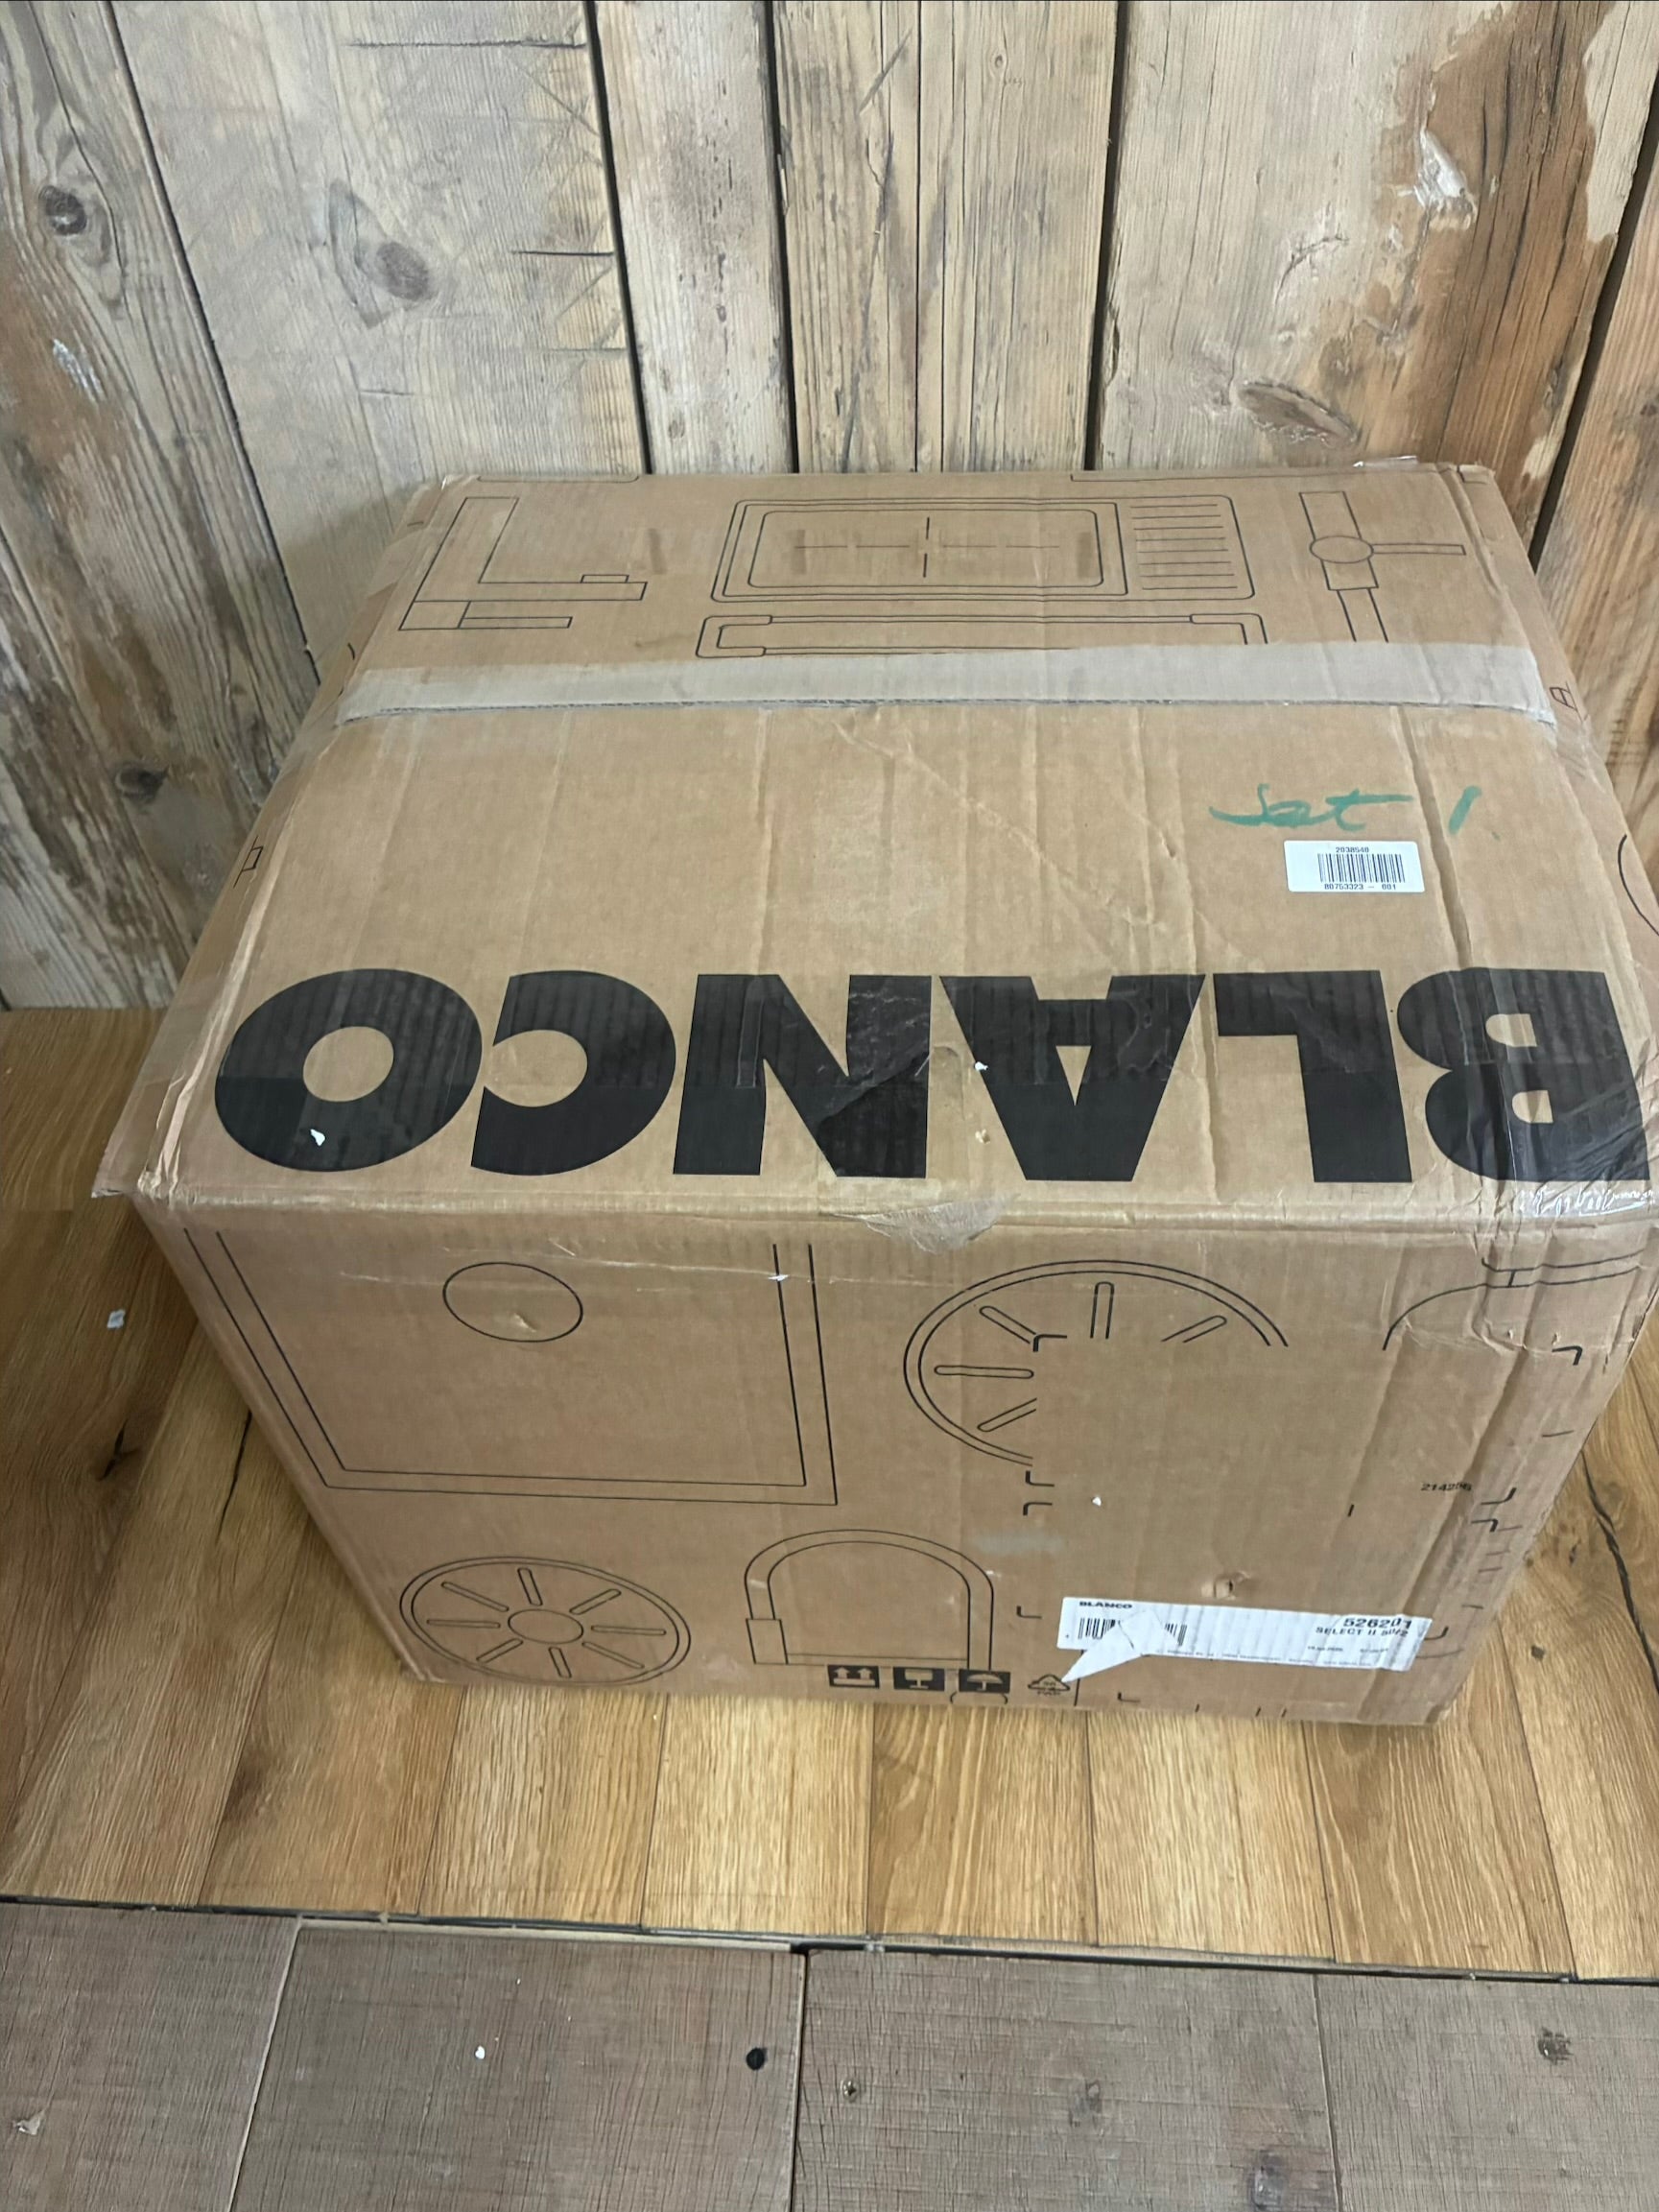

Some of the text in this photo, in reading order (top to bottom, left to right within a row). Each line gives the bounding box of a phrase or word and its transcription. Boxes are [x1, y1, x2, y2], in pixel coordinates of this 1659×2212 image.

[214, 967, 1650, 1183] BLANCO
[1079, 1600, 1133, 1609] BLANCO
[1343, 1616, 1412, 1630] 526201
[1315, 1626, 1363, 1636] SELECT
